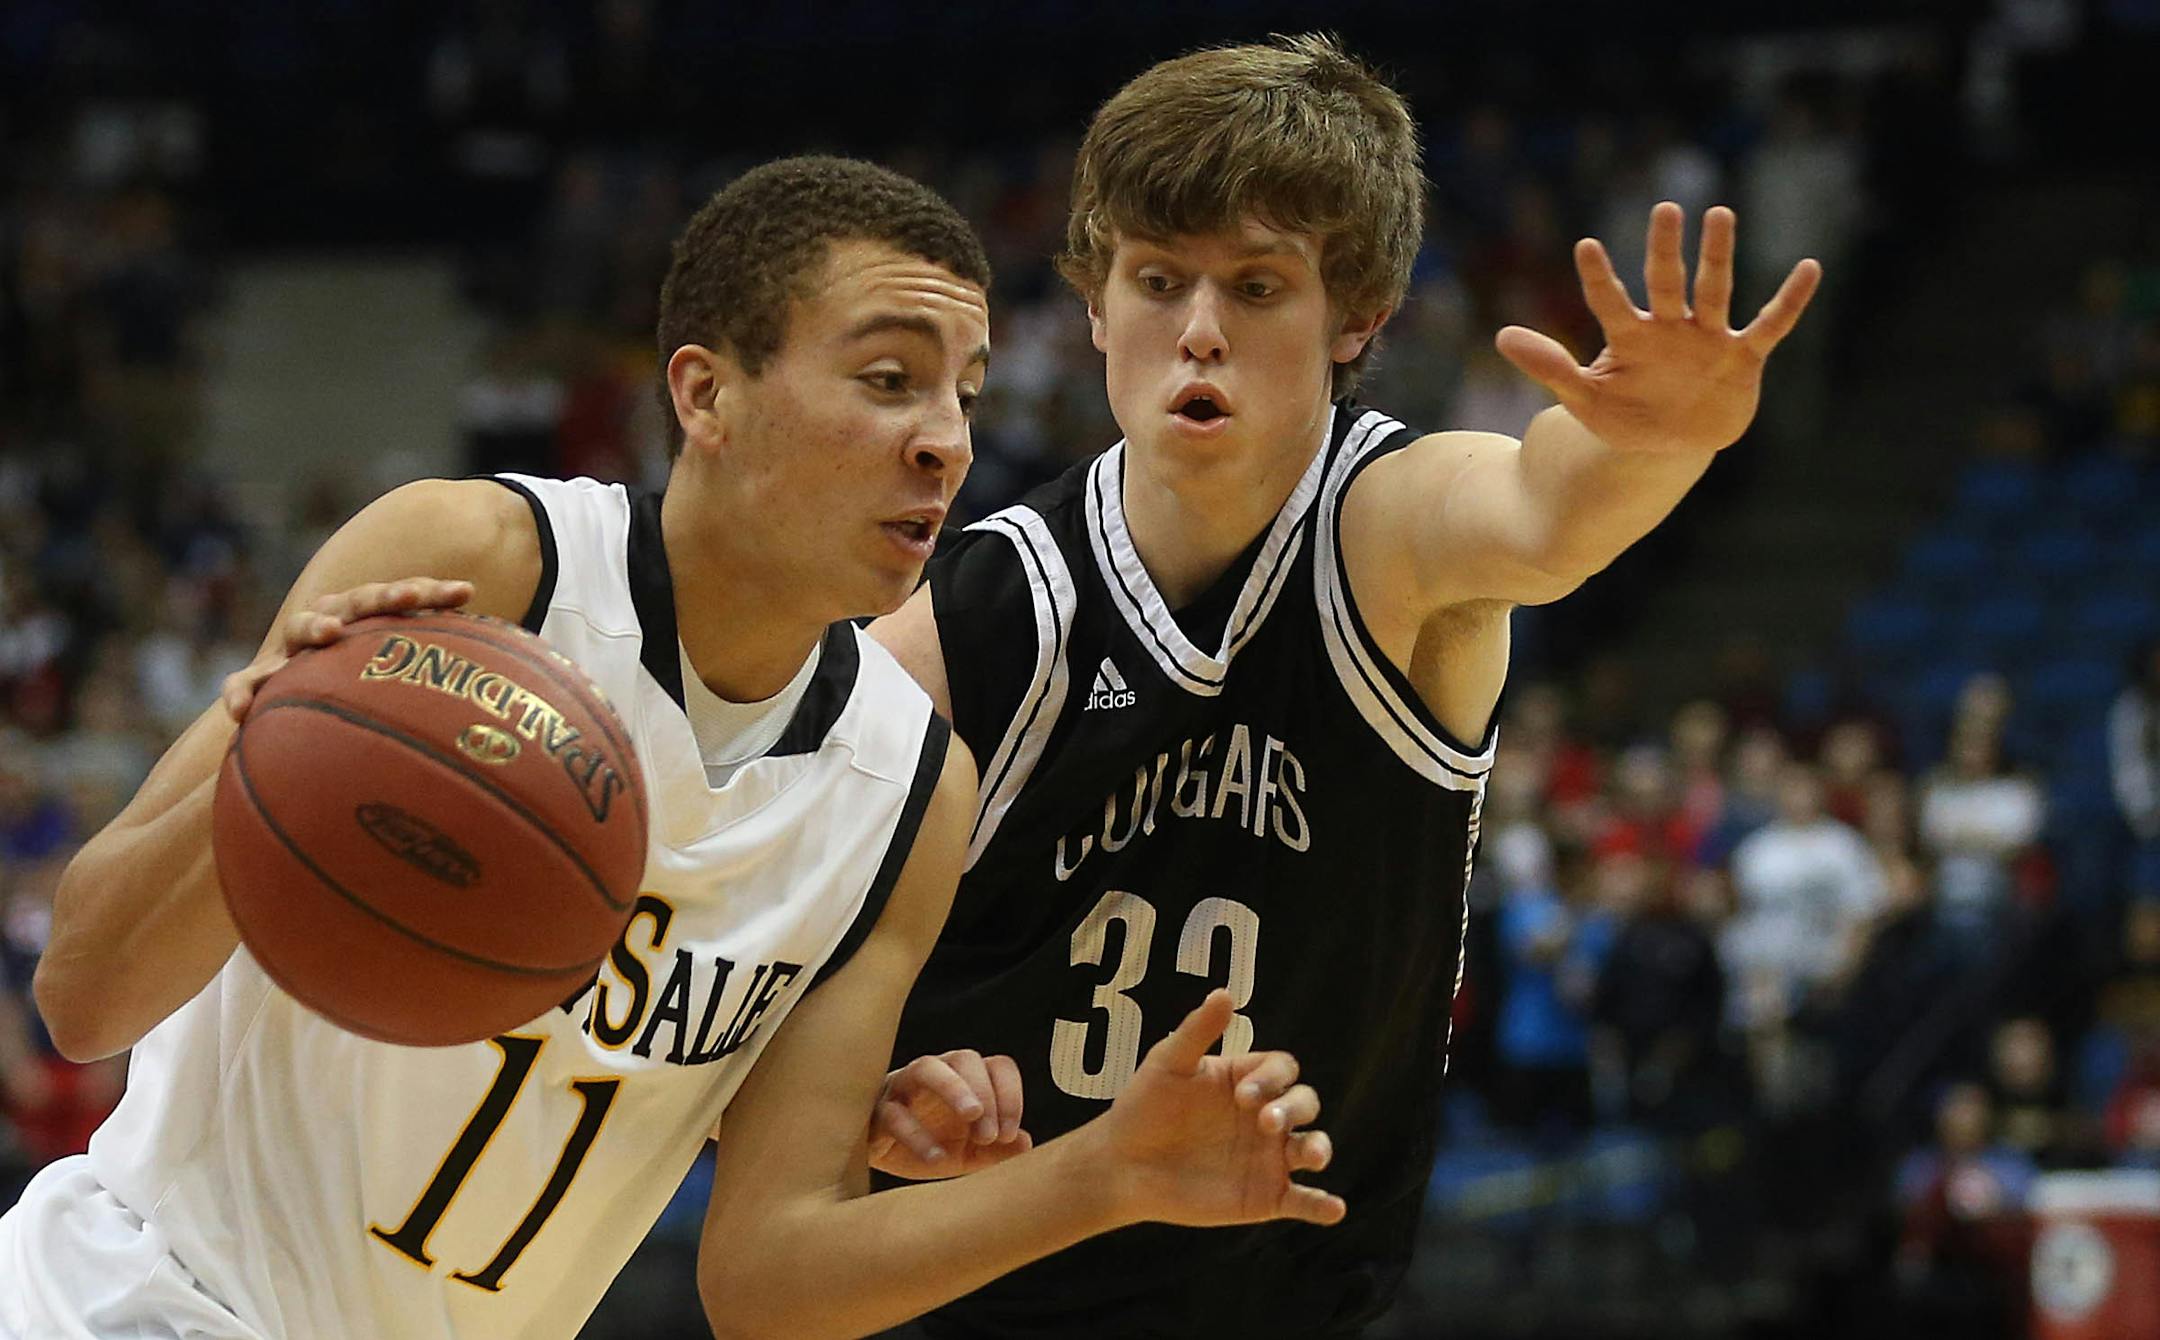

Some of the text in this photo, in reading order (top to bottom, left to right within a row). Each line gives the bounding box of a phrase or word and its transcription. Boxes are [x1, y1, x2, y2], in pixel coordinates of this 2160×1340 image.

[361, 634, 626, 823] SPALDING
[1083, 690, 1136, 711] didas
[558, 891, 804, 1066] SALLE
[366, 1032, 627, 1292] 11
